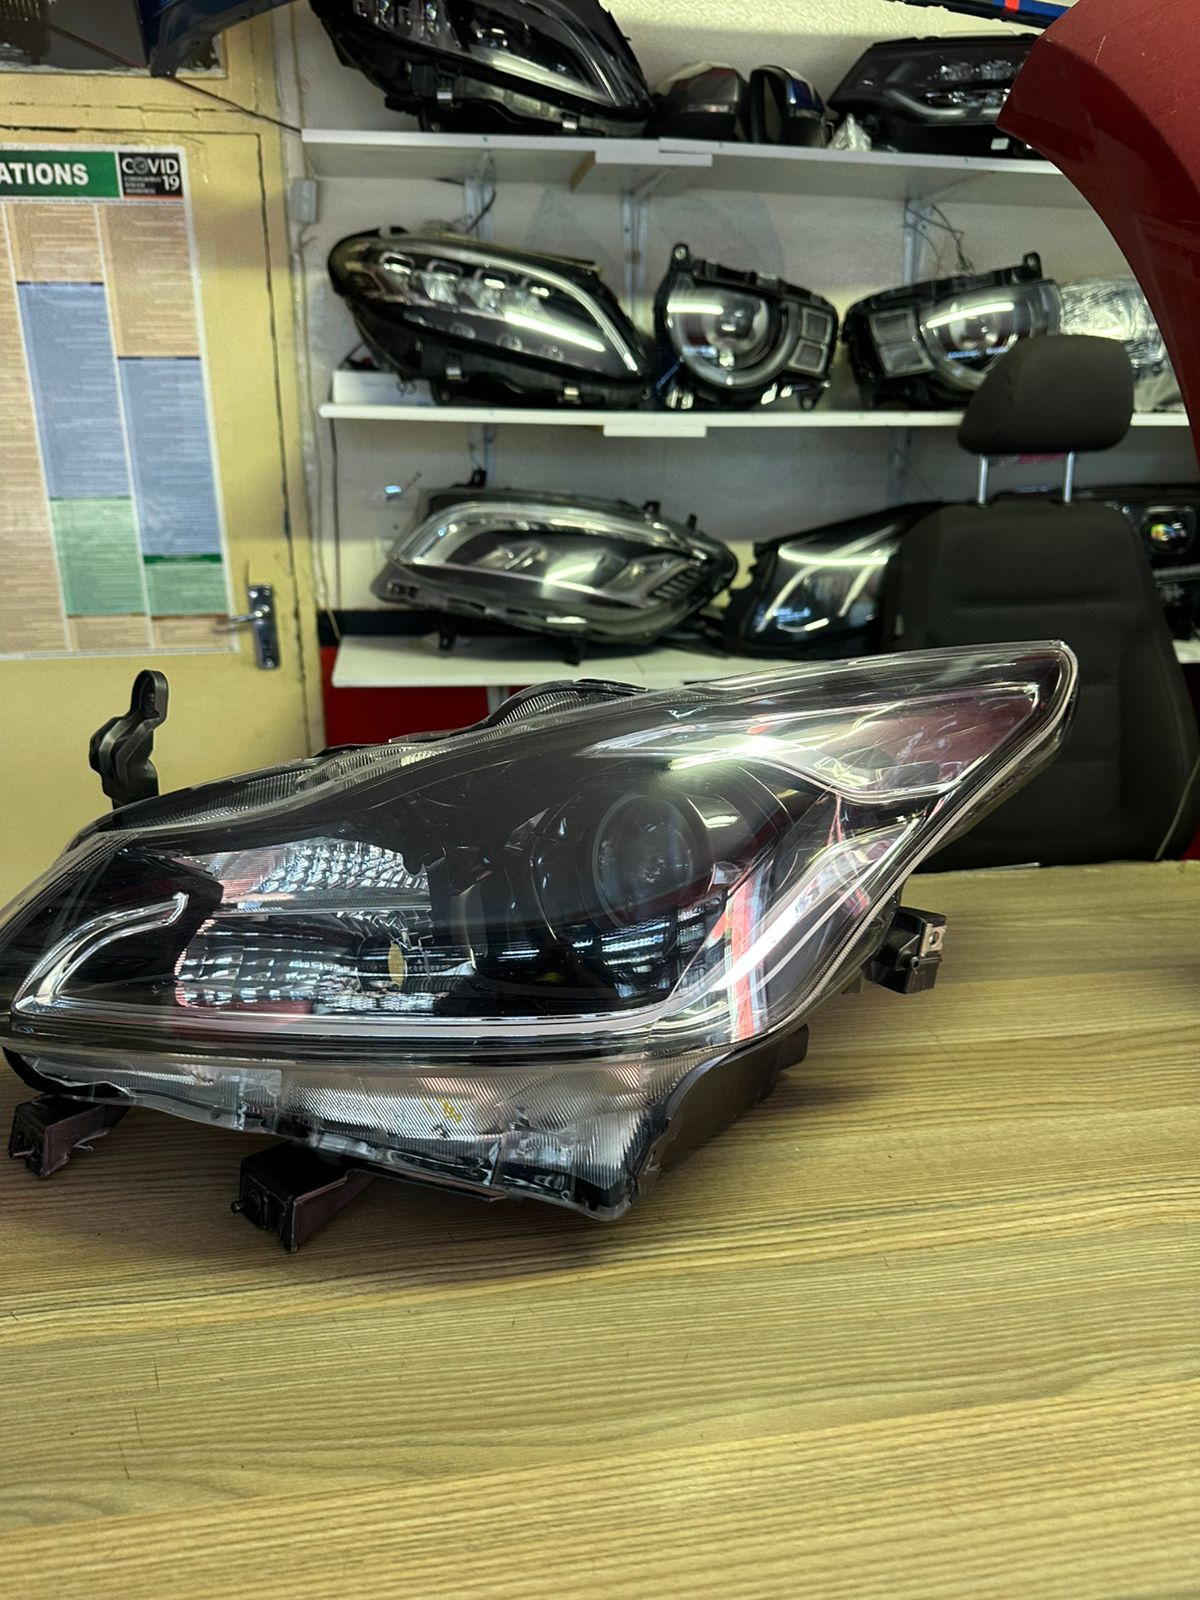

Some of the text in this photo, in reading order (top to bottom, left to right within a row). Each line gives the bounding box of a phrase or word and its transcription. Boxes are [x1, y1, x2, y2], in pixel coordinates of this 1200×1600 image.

[0, 162, 90, 186] ATIONS
[121, 156, 180, 175] COVID
[162, 175, 180, 191] 19
